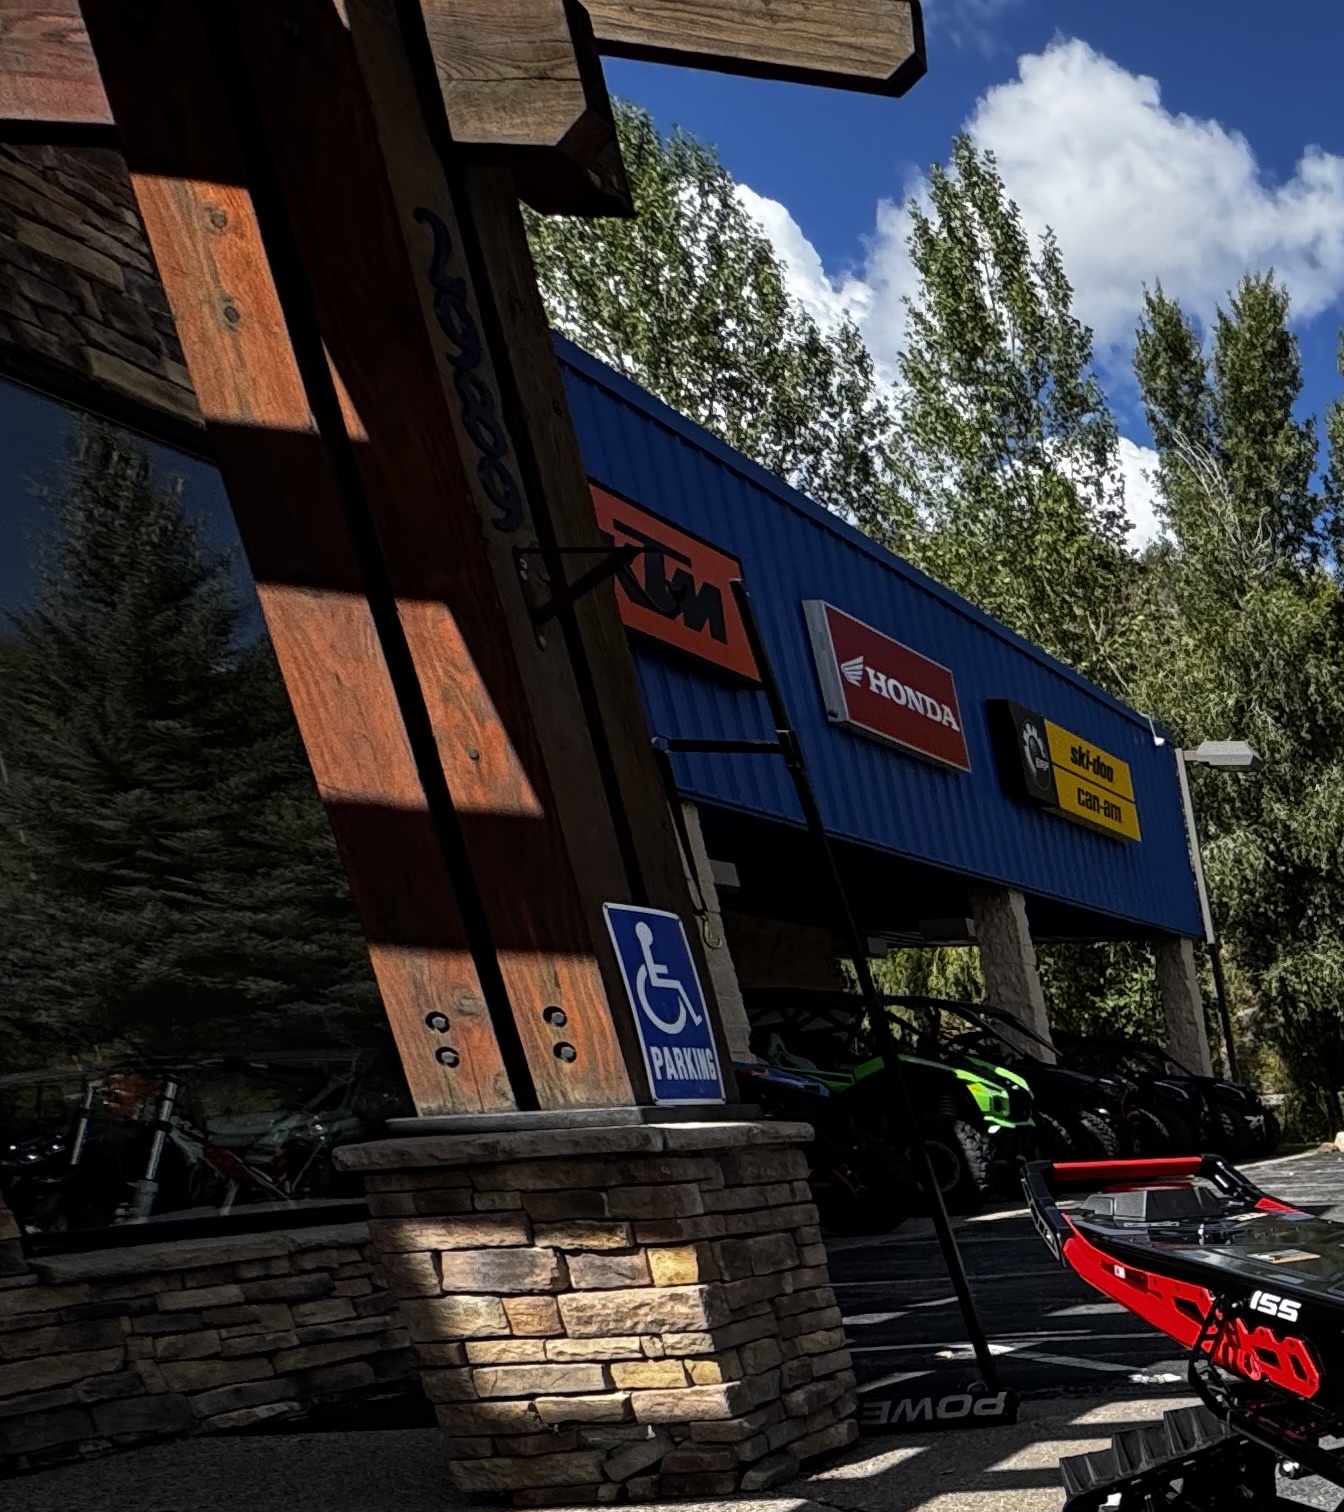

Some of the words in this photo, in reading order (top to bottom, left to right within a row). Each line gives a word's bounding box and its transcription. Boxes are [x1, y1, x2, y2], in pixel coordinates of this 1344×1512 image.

[864, 666, 962, 733] HONDA
[1069, 745, 1115, 784] ski-doo
[1076, 786, 1123, 824] can-am
[649, 1045, 718, 1082] PARKING
[1248, 1289, 1303, 1323] 155
